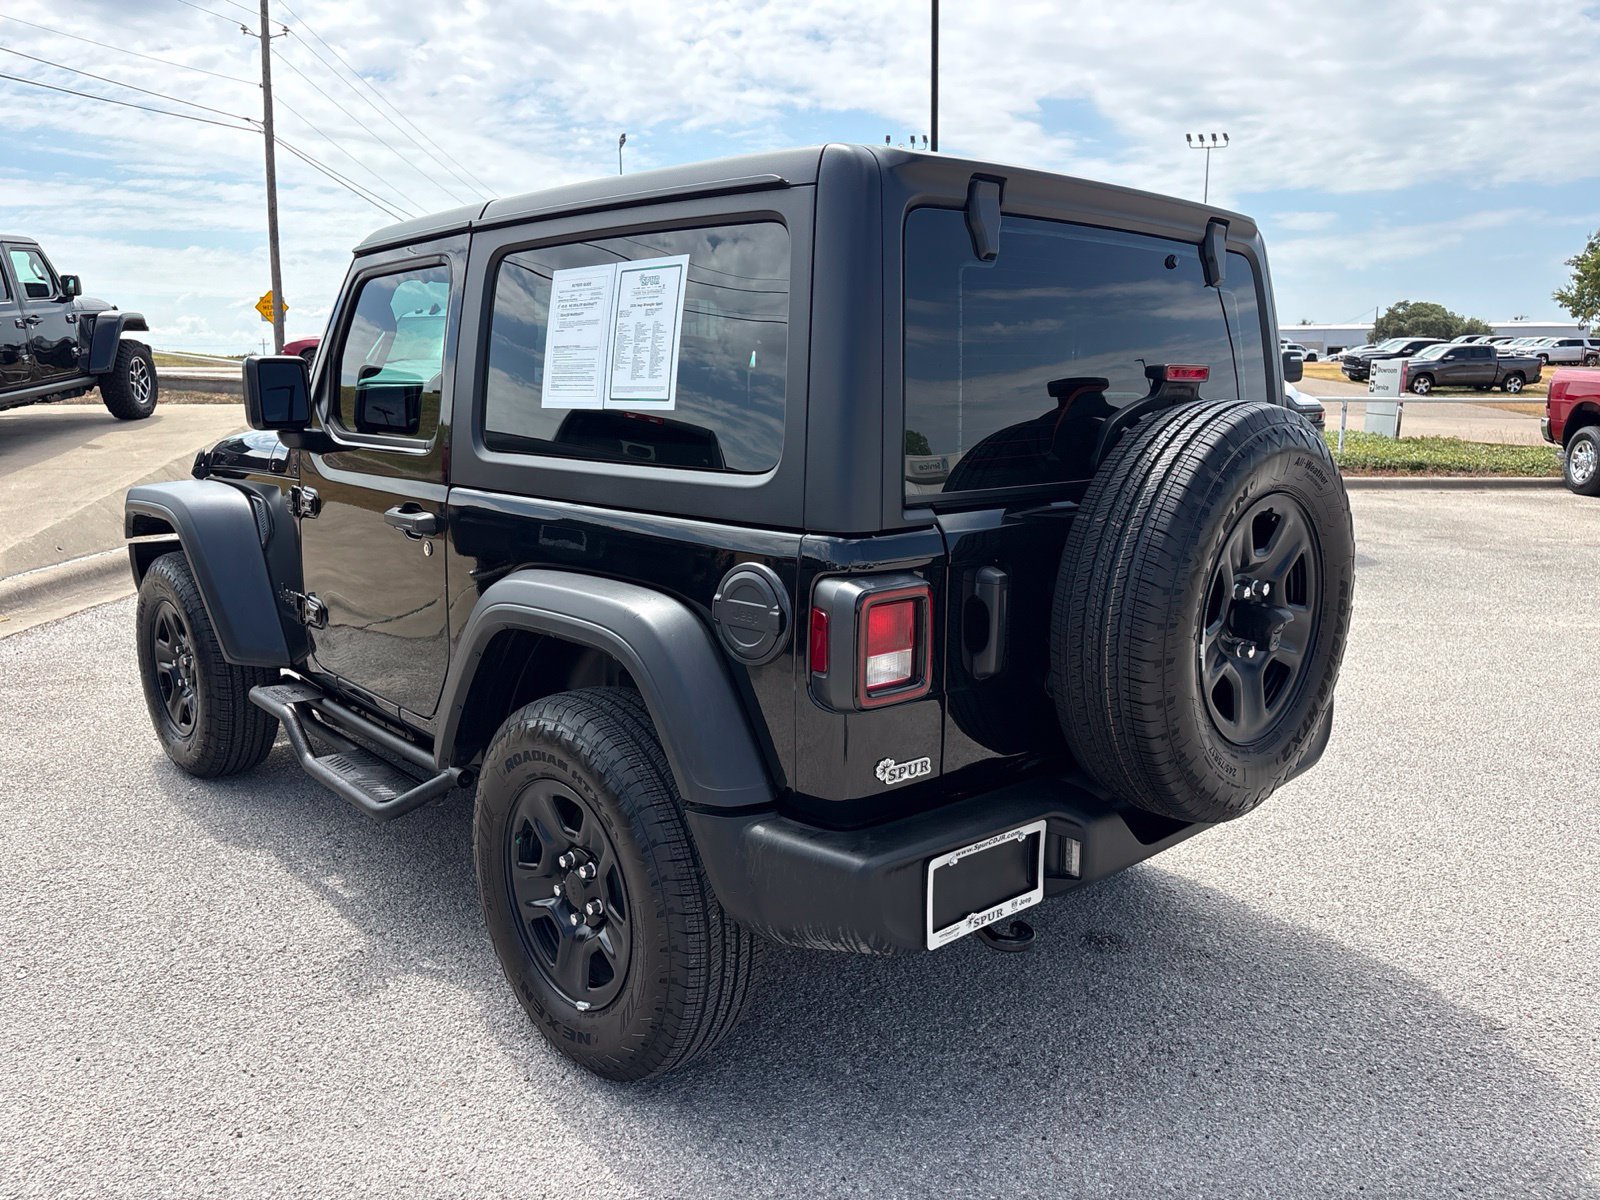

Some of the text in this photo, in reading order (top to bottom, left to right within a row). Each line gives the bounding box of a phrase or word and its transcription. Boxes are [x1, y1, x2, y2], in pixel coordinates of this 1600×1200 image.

[1377, 366, 1398, 374] Showroom
[1293, 456, 1328, 485] All-Weather
[504, 749, 570, 774] ROADIAN
[888, 760, 929, 781] SPUR
[955, 830, 1021, 857] www.SpurCDJR.com
[972, 908, 1004, 928] SPUR
[519, 980, 591, 1046] NEXEN
